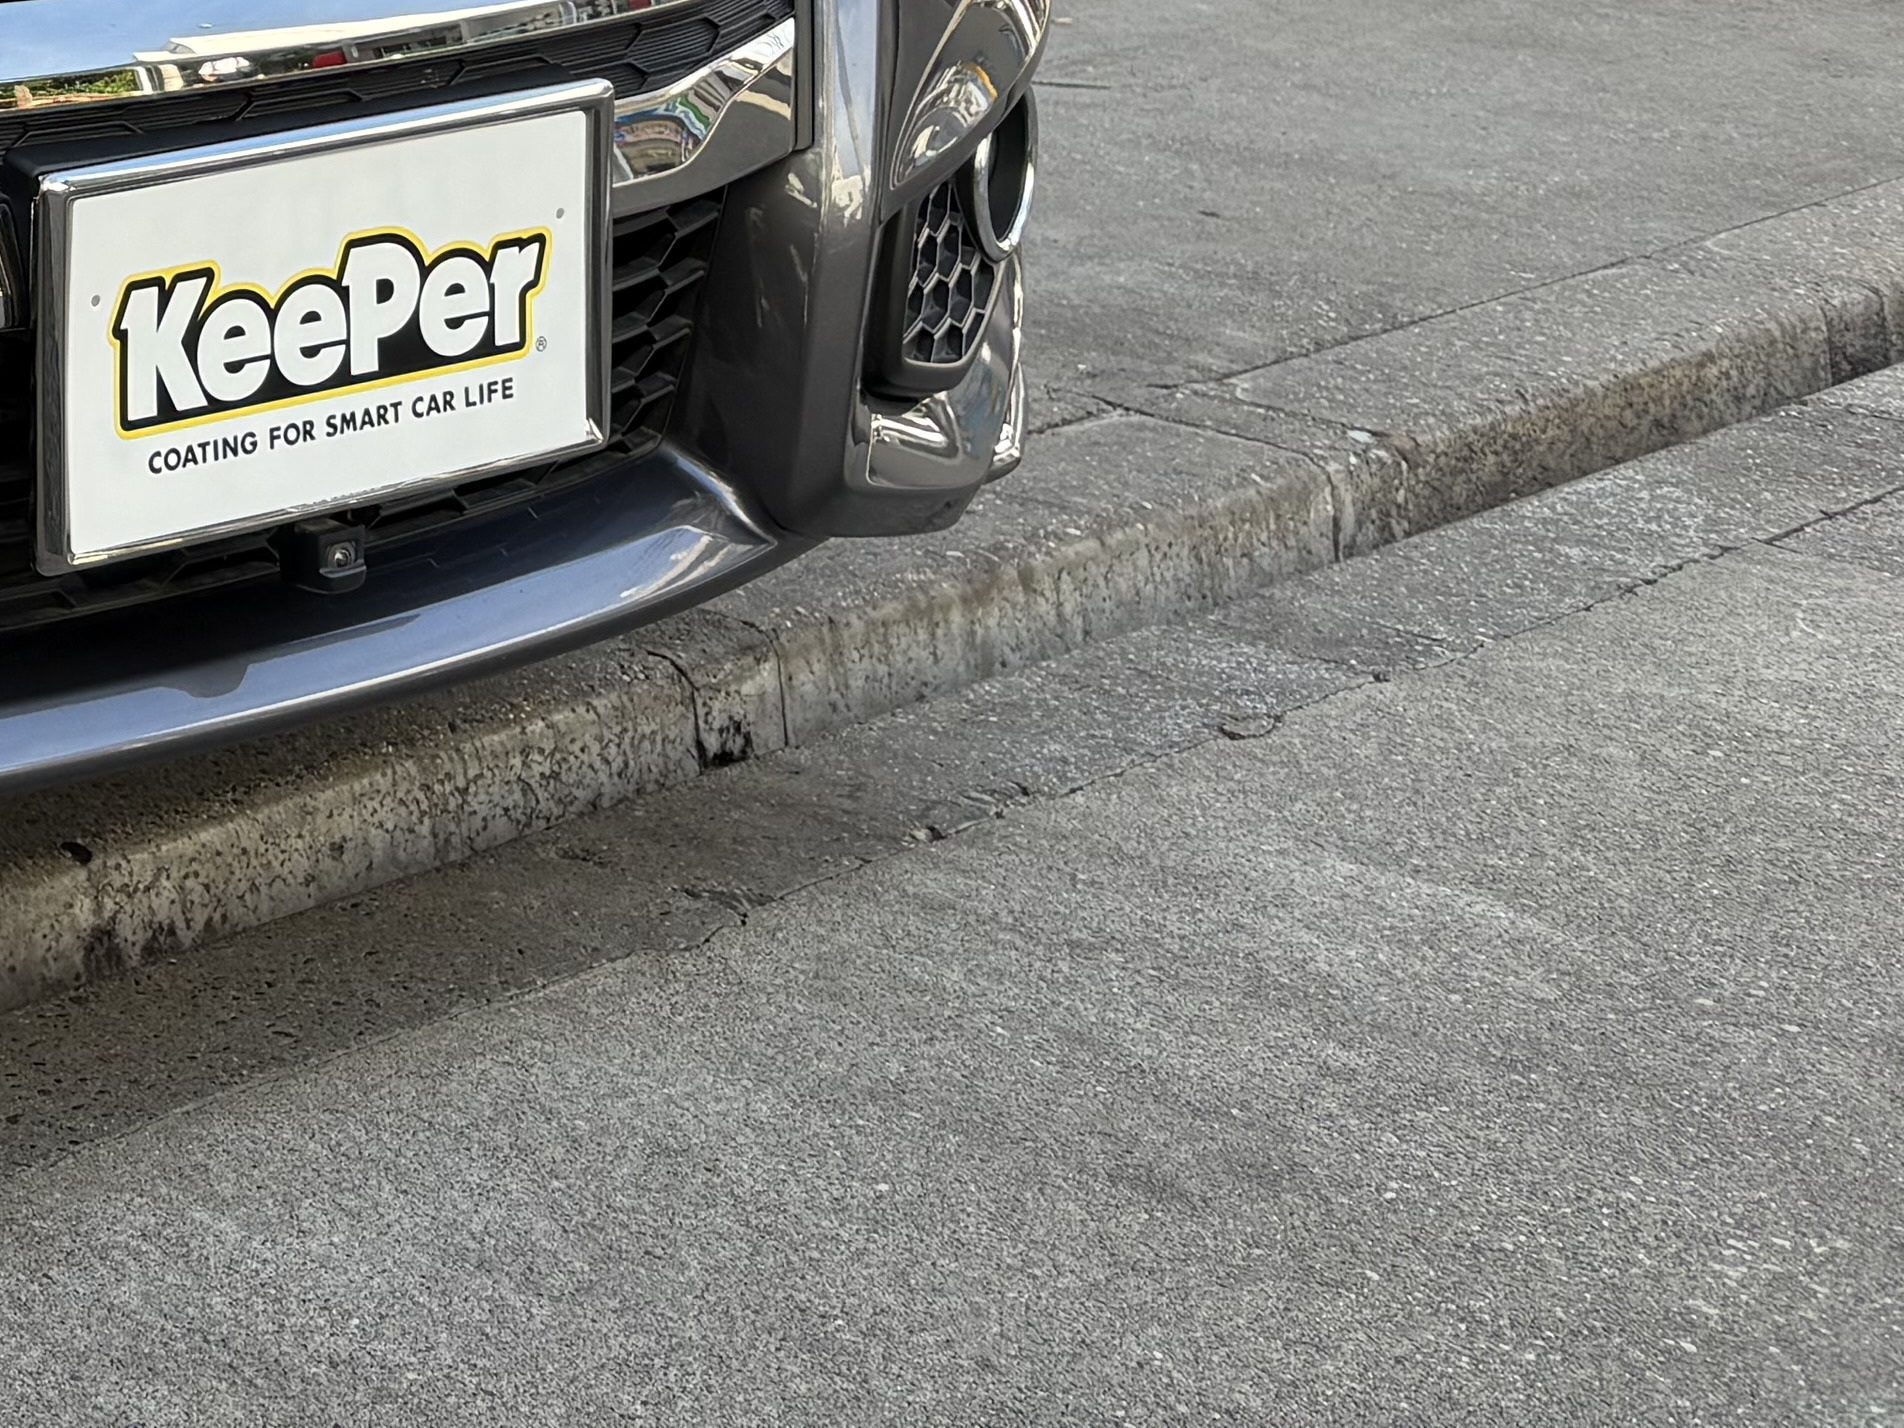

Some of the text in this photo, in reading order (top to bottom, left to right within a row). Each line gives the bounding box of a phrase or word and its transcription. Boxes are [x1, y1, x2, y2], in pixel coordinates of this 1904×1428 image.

[114, 231, 548, 432] KeePer
[148, 376, 515, 476] COATING FOR SMART CAR LIFE
